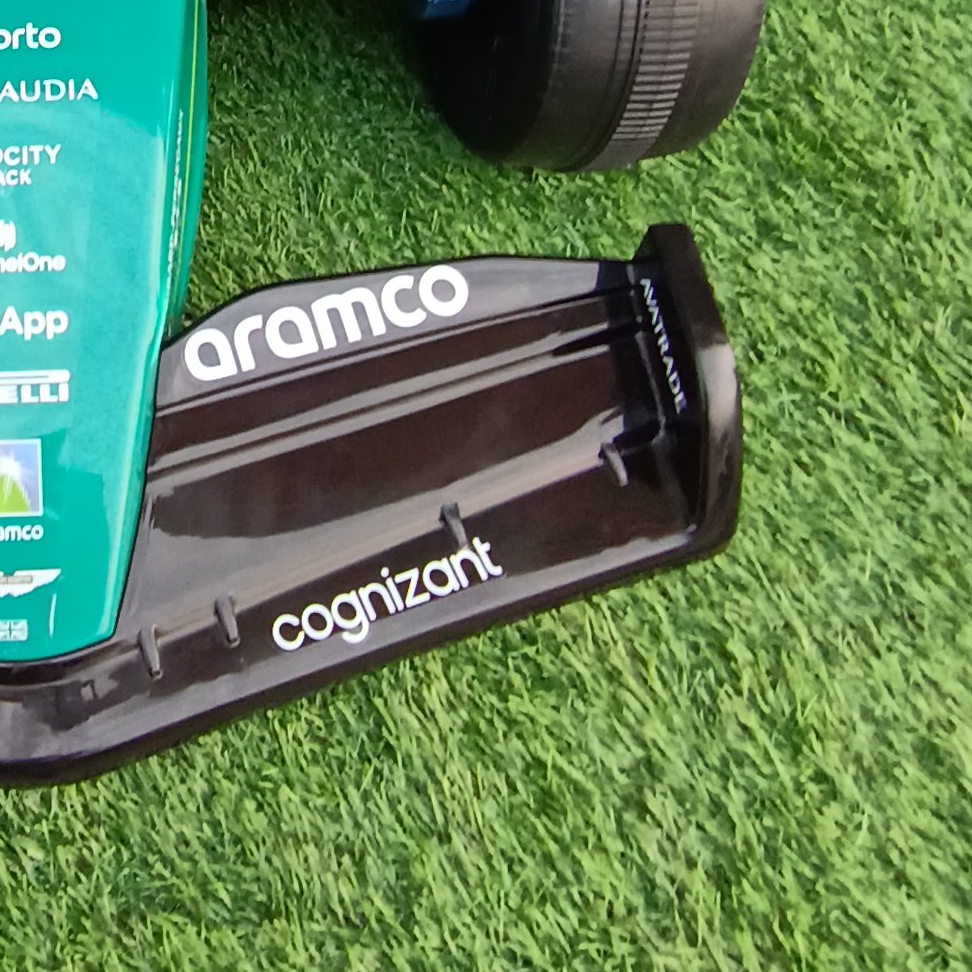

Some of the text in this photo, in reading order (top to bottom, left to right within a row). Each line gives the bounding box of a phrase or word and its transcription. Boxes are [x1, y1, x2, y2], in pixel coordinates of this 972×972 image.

[184, 264, 468, 382] aramco
[638, 277, 687, 415] AVATRADE
[271, 536, 504, 651] cognizant
